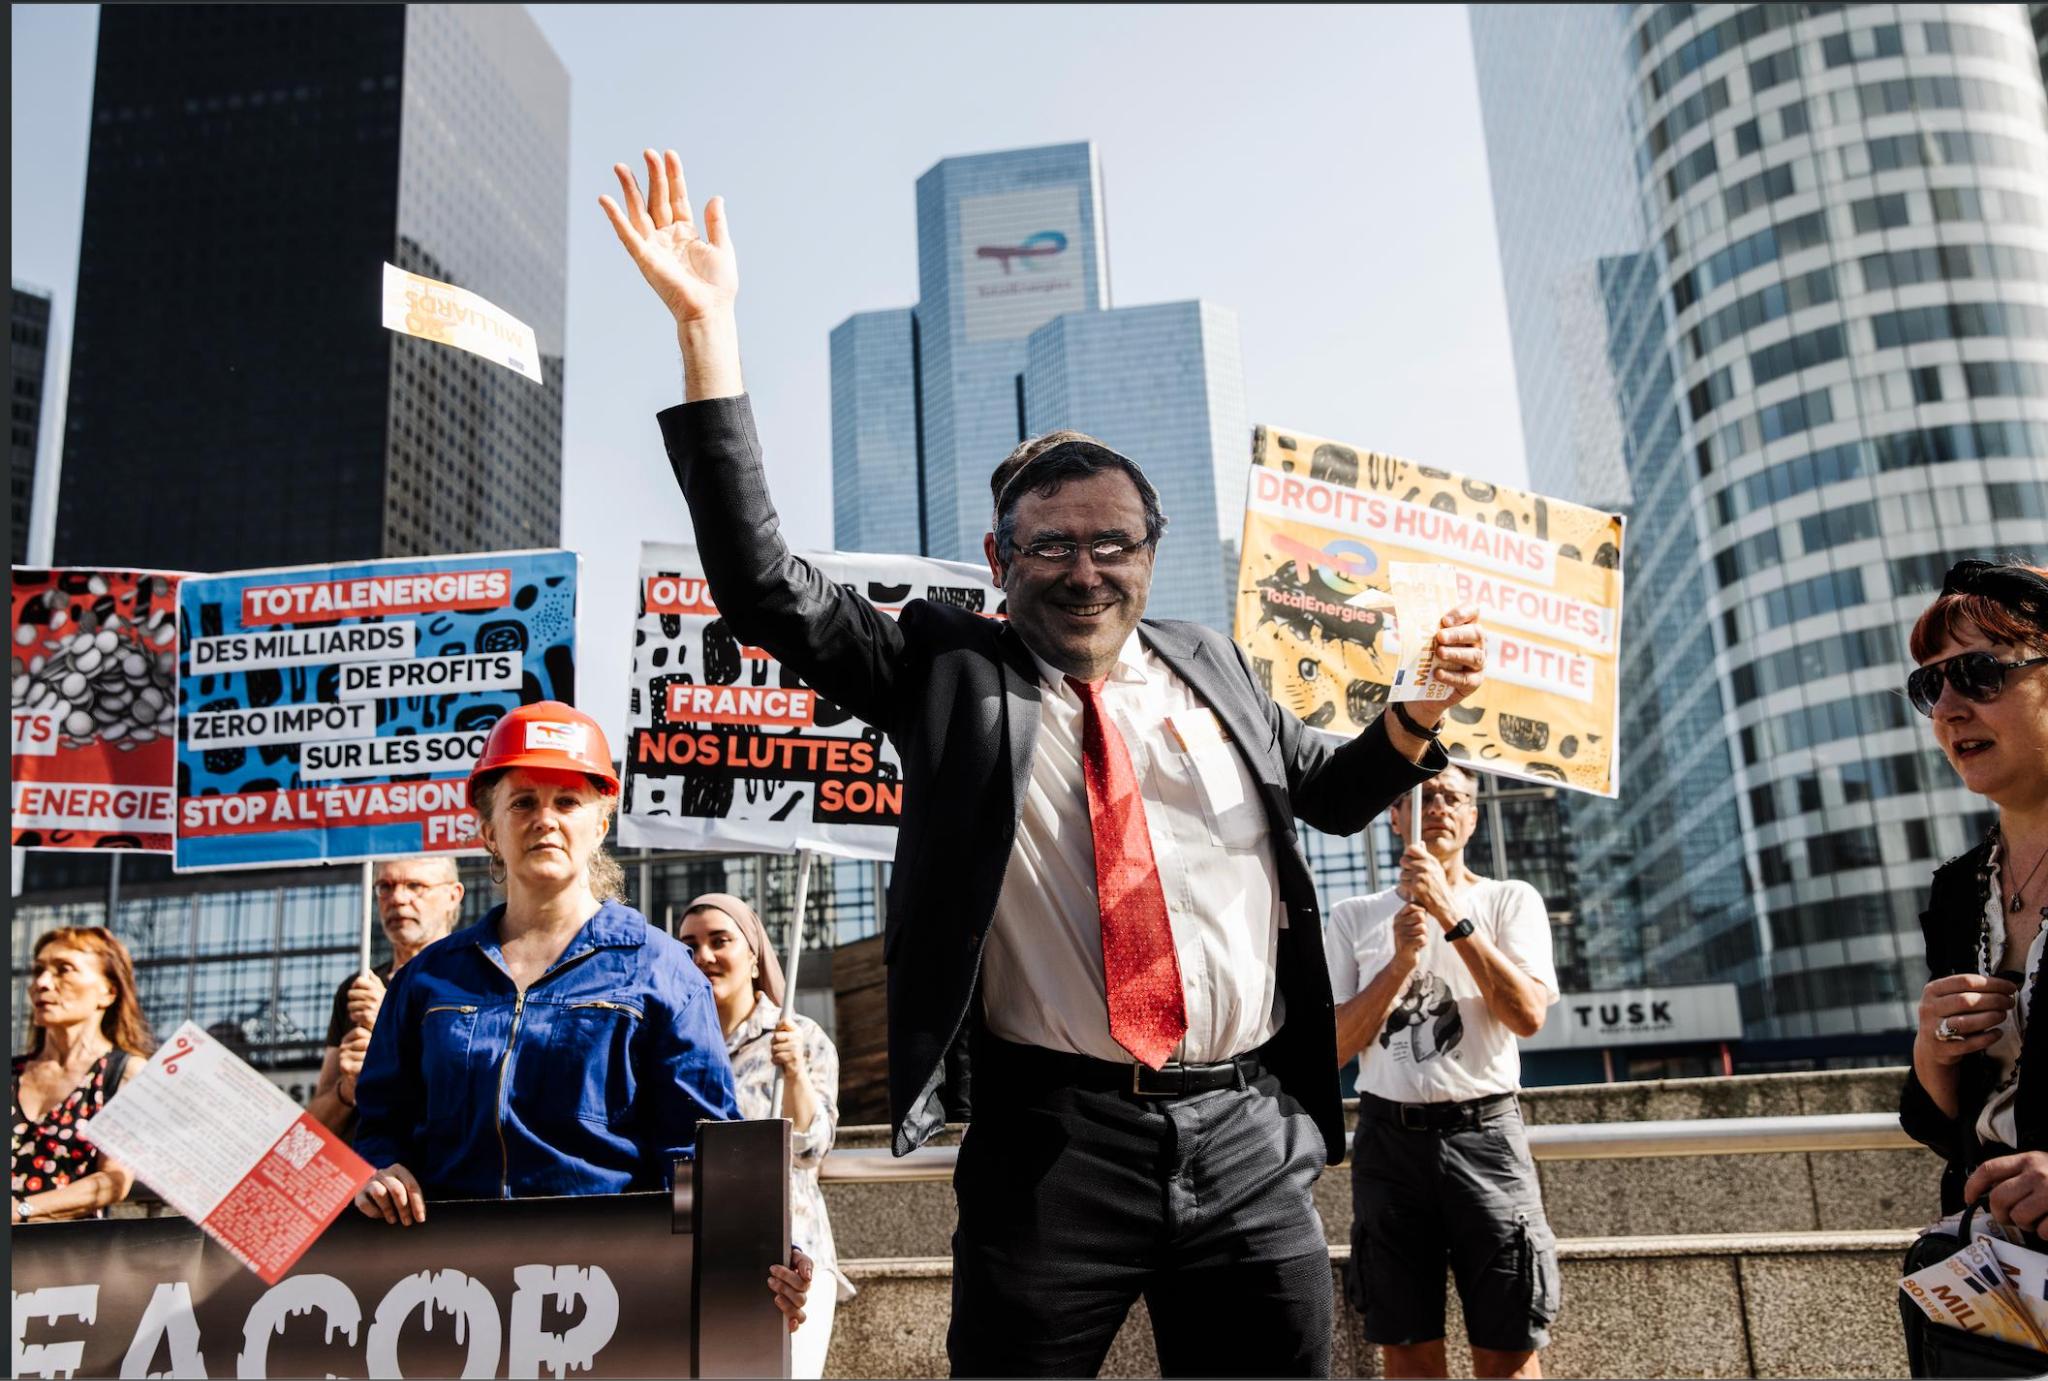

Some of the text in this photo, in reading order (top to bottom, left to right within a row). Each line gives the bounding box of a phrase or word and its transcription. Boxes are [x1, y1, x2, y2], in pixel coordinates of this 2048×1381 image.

[1257, 472, 1545, 571] DROITS HUMAINS
[247, 572, 506, 617] TOTALENERGIES
[1260, 586, 1377, 624] TotalEnergies
[197, 626, 404, 664] DES MILLIARDS
[346, 656, 511, 690] DE PROFITS
[1500, 640, 1586, 688] PITIÉ
[672, 686, 809, 718] FRANCE
[14, 714, 52, 743] TS
[307, 735, 486, 770] SUR LES SOC
[638, 731, 874, 774] NOS LUTTES
[12, 787, 173, 820] ENERGIE
[184, 781, 466, 828] STOP À L'ÉVASION
[428, 813, 481, 843] FIS
[1575, 1001, 1673, 1027] TUSK
[1903, 1279, 1925, 1298] 80
